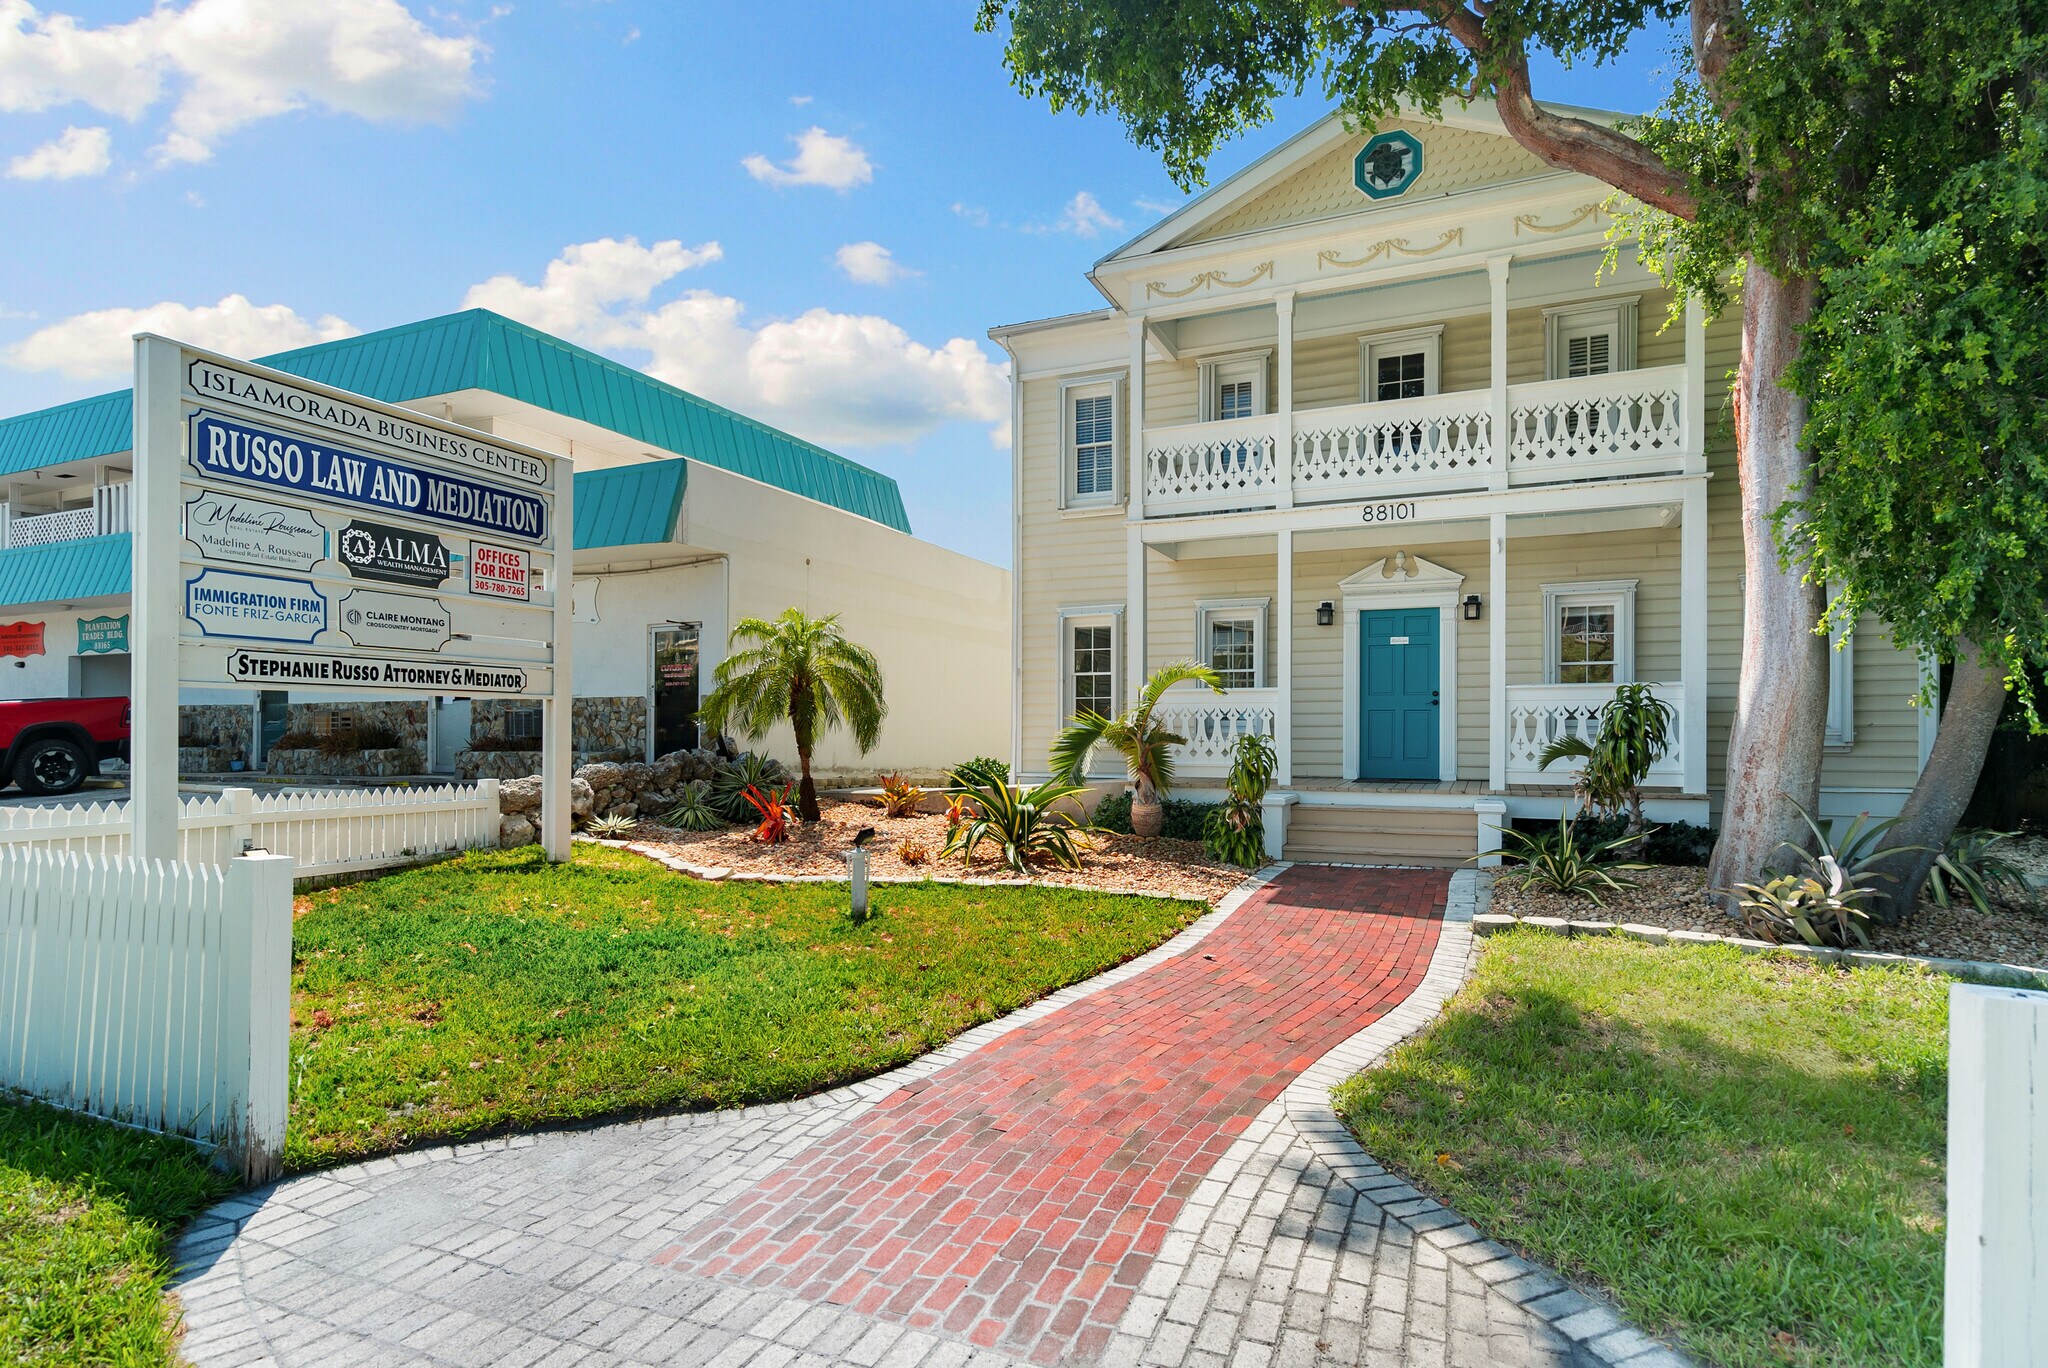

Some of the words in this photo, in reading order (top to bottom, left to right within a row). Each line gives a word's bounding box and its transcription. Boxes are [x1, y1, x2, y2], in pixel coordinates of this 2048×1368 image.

[202, 369, 372, 433] ISLAMORADA
[377, 419, 468, 458] BUSINESS
[472, 447, 541, 479] CENTER
[207, 424, 304, 484] RUSSO
[310, 450, 367, 497] LAW
[370, 465, 421, 508] AND
[426, 478, 539, 534] MEDIATION
[193, 501, 265, 535] Madeline
[258, 511, 320, 537] Rousseau
[1362, 503, 1415, 522] 88101
[202, 534, 251, 550] Madeline
[253, 542, 265, 552] A.
[268, 544, 312, 559] Rousseau
[352, 539, 366, 554] A
[377, 536, 447, 568] ALMA
[377, 559, 403, 569] WEALTH
[404, 564, 447, 576] MANAGEMENT
[477, 548, 520, 567] OFFICES
[474, 561, 496, 578] FOR
[498, 565, 526, 582] RENT
[474, 580, 525, 596] 305-780-7265
[194, 587, 287, 610] IMMIGRATION
[290, 598, 321, 613] FIRM
[195, 603, 239, 617] FONTE
[243, 608, 321, 625] FRIZ-GARCIA
[366, 611, 398, 622] CLAIRE
[400, 615, 445, 627] MONTANG
[82, 631, 104, 641] TRADES
[85, 621, 121, 631] PLANTATION
[366, 621, 409, 631] CROSSCOUNTRY
[238, 654, 329, 679] STEPHANIE
[332, 660, 379, 681] RUSSO
[383, 663, 450, 685] ATTORNEY
[451, 668, 462, 685] &
[464, 668, 522, 688] MEDIATOR
